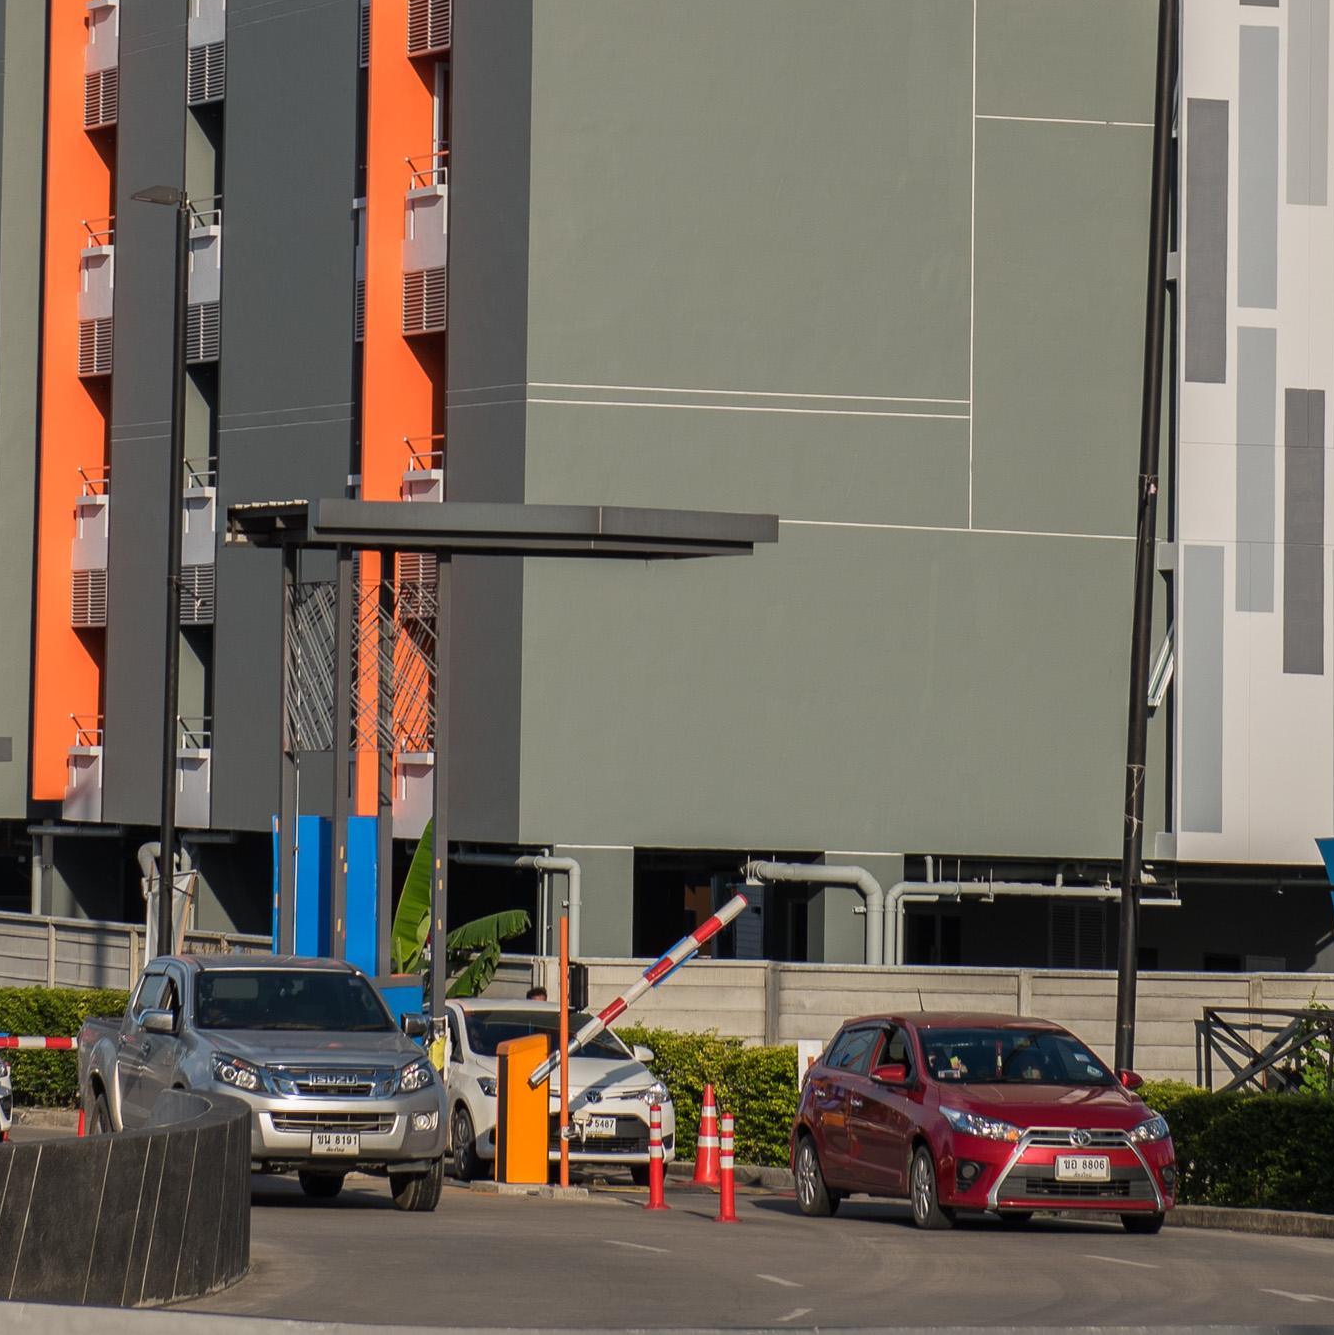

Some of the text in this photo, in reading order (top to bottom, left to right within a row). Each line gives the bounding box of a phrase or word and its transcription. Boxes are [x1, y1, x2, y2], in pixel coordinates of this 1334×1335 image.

[312, 1073, 357, 1084] ISUZU
[335, 1135, 357, 1145] 8191
[1082, 1159, 1105, 1170] 8806
